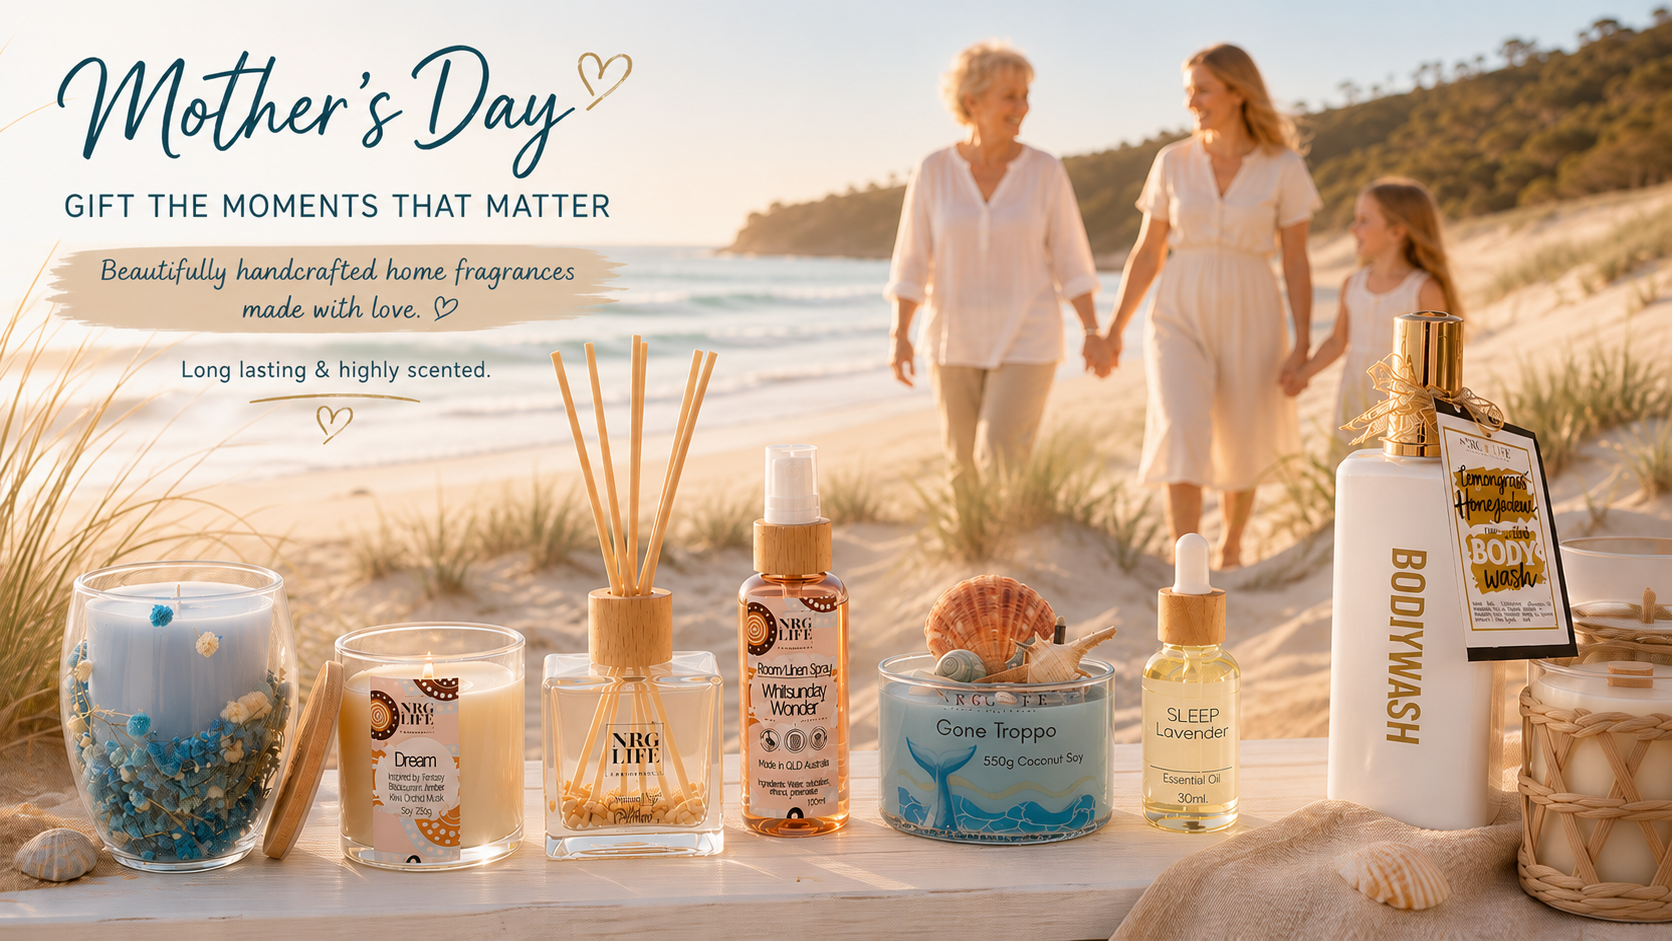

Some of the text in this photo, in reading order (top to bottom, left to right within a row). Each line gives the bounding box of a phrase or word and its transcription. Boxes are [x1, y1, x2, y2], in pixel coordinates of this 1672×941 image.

[1470, 538, 1536, 566] BODY
[1484, 562, 1538, 588] wash
[780, 617, 812, 629] NRG
[779, 629, 813, 641] LIFE
[810, 663, 833, 678] Spray
[401, 702, 434, 713] NRG
[770, 699, 819, 716] Wonder
[1167, 707, 1220, 723] SLEEP
[401, 713, 434, 725] LIFE
[936, 718, 1057, 744] Gone Troppo
[1156, 722, 1229, 740] Lavender
[612, 732, 659, 748] NRG
[394, 751, 437, 768] Dream
[612, 748, 660, 764] LIFE
[983, 752, 1084, 770] 550g Coconut Soy
[786, 760, 803, 770] QLD
[1163, 773, 1221, 785] Essential Oil
[1177, 792, 1209, 804] 30ml.
[401, 806, 413, 817] Soy
